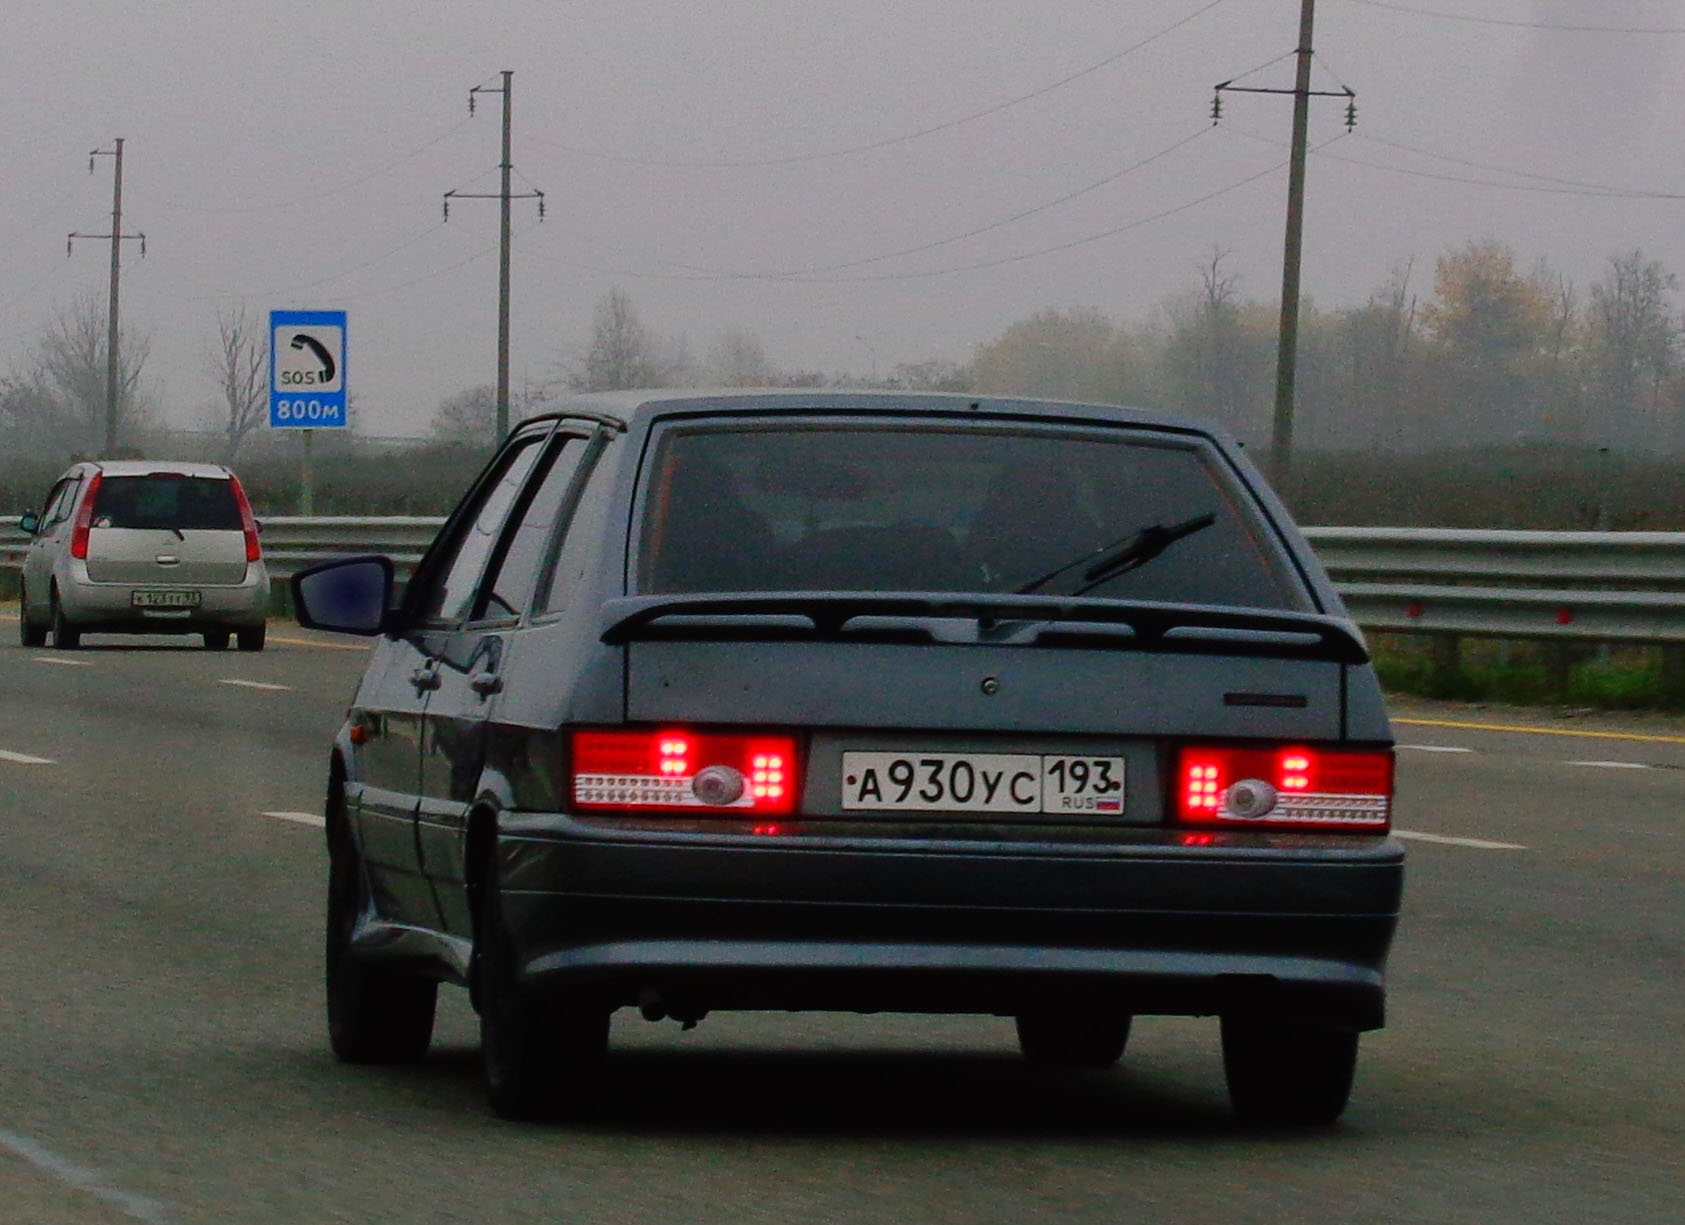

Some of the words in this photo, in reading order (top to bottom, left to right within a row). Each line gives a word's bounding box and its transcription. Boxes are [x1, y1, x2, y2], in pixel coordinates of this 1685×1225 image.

[281, 371, 315, 385] SOS
[1048, 760, 1112, 793] 193
[1062, 796, 1094, 809] RUS
